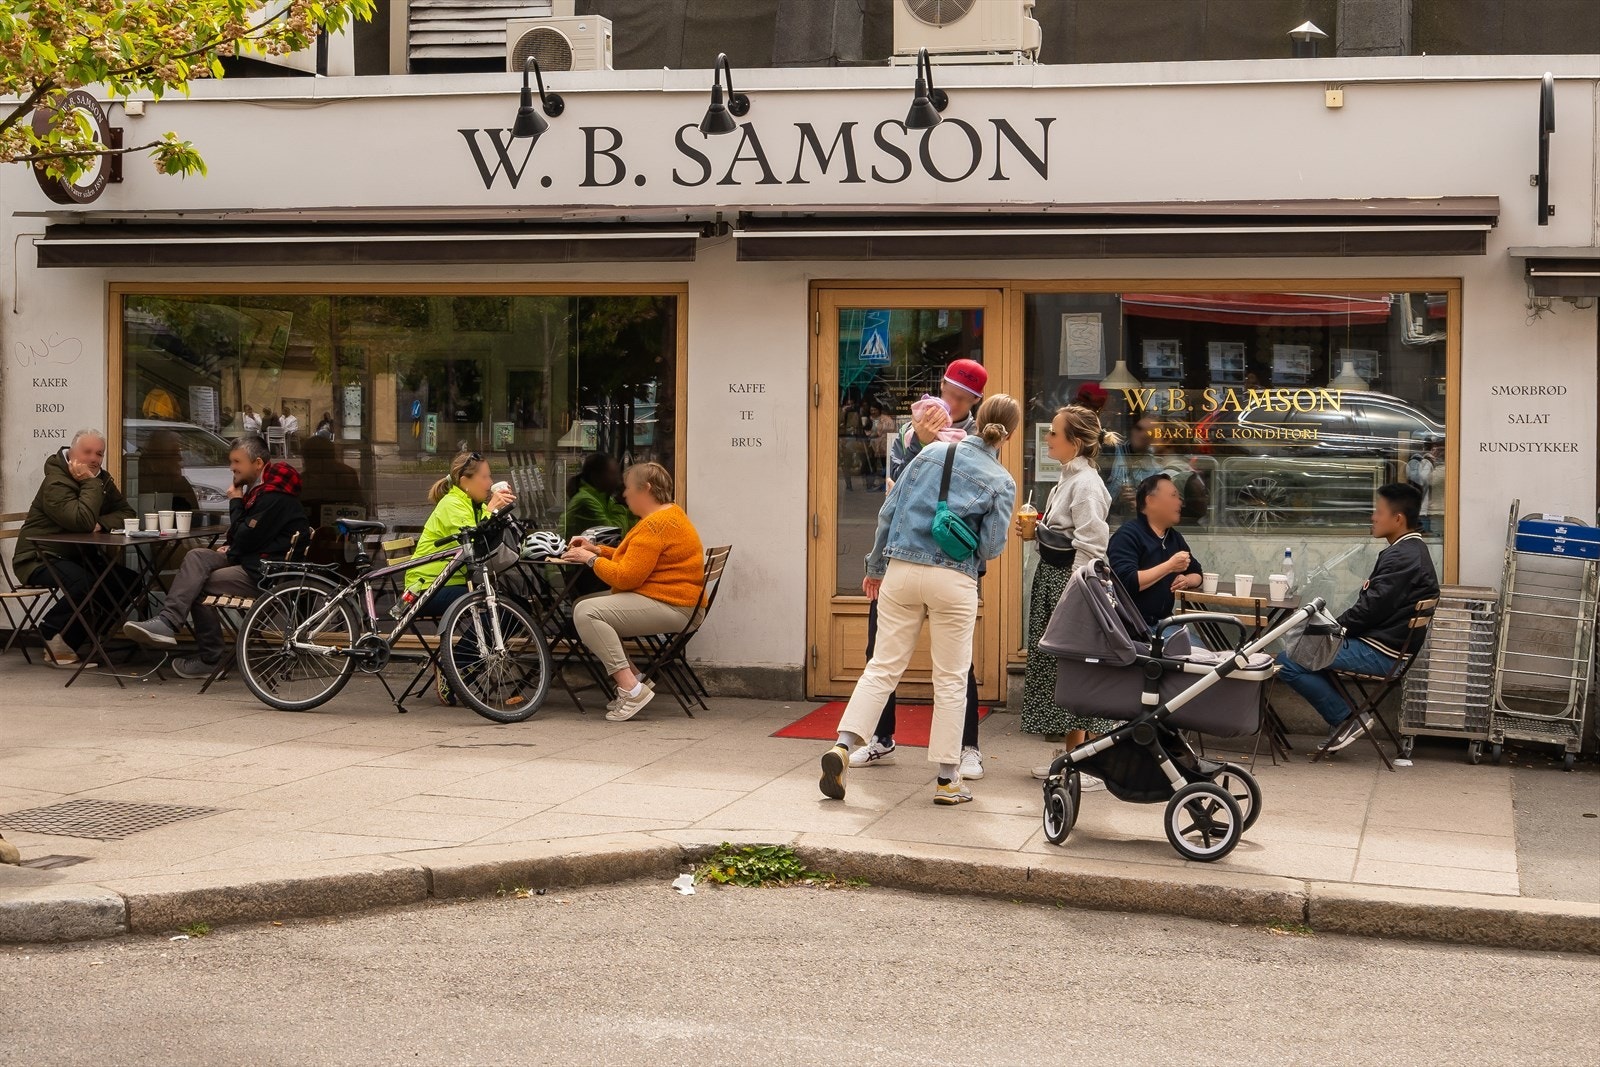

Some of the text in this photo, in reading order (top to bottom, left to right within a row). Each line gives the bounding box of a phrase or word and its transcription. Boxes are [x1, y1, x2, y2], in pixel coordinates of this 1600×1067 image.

[76, 95, 103, 123] SAMSON
[457, 117, 1057, 190] W. B. SAMSON
[32, 378, 68, 388] KAKER
[728, 383, 766, 393] KAFFE
[1491, 385, 1567, 396] SMØRBRØD
[1121, 387, 1342, 413] W. B. SAMSON
[35, 403, 65, 413] BRØD
[739, 410, 754, 420] TE
[1508, 413, 1551, 424] SALAT
[33, 428, 67, 439] BAKST
[1153, 427, 1319, 441] BAKERI & KONDITORI
[731, 437, 763, 448] BRUS
[1479, 442, 1579, 453] RUNDSTYKKER
